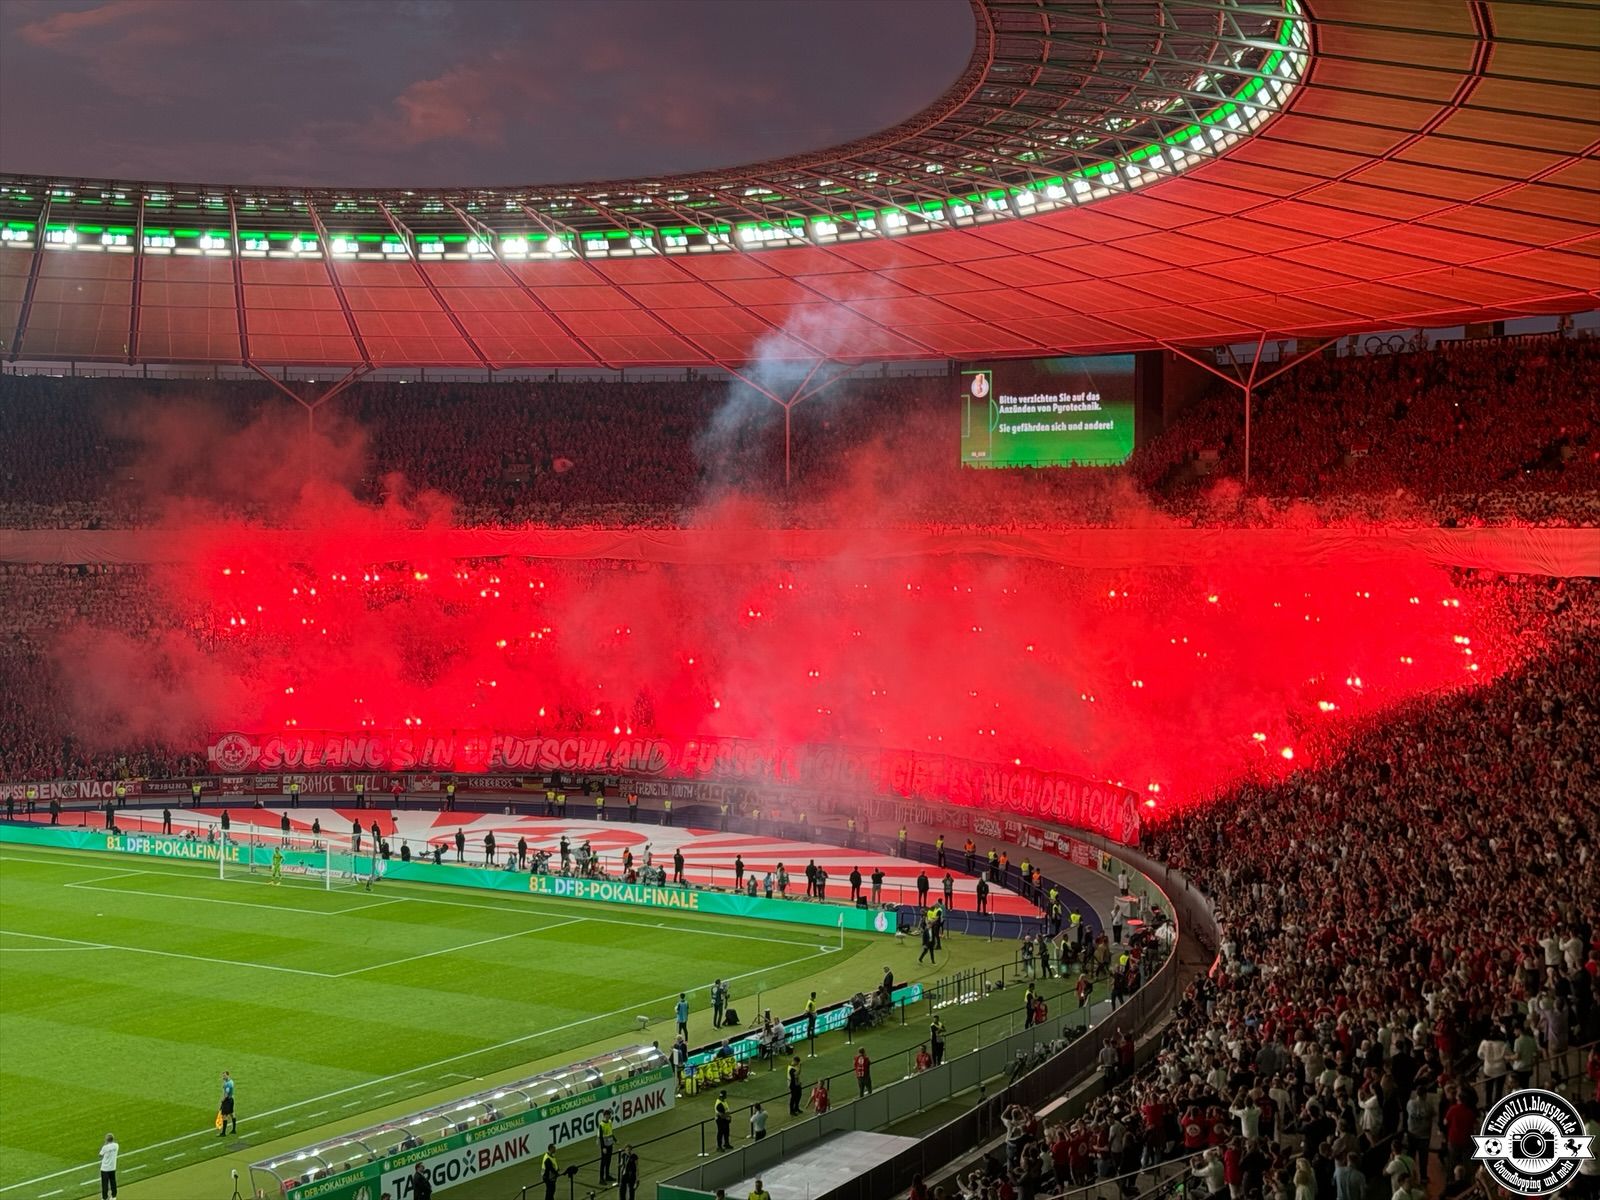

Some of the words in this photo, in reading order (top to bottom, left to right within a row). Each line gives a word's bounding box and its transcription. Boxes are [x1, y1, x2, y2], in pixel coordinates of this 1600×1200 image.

[999, 395, 1018, 405] Bitte
[1018, 394, 1058, 404] verzichten
[1059, 393, 1071, 402] Sie
[1072, 392, 1086, 402] auf
[1086, 392, 1100, 401] das
[999, 403, 1036, 414] Anzünden
[1037, 404, 1052, 413] von
[1052, 402, 1102, 414] Pyrotechnik.
[999, 424, 1011, 433] Sie
[1011, 422, 1050, 434] gefährden
[1051, 422, 1067, 431] sich
[1068, 421, 1083, 431] und
[1083, 420, 1114, 431] andere!
[301, 774, 336, 793] BÖHSE
[420, 737, 454, 766] IN
[981, 768, 1035, 810] AUCH
[1039, 779, 1078, 819] DEN
[468, 777, 514, 788] KERBEROS
[635, 781, 669, 796] FRENETIC
[671, 784, 694, 798] YOUTH
[106, 836, 125, 851] 81.
[127, 837, 240, 862] DFB-POKALFINALE
[529, 876, 552, 894] 81.
[555, 878, 698, 909] DFB-POKALFINALE
[474, 1117, 525, 1140] DFB-POKALFINALE
[393, 1143, 449, 1168] DFB-POKALFINALE
[303, 1170, 365, 1198] DFB-POKALFINALE
